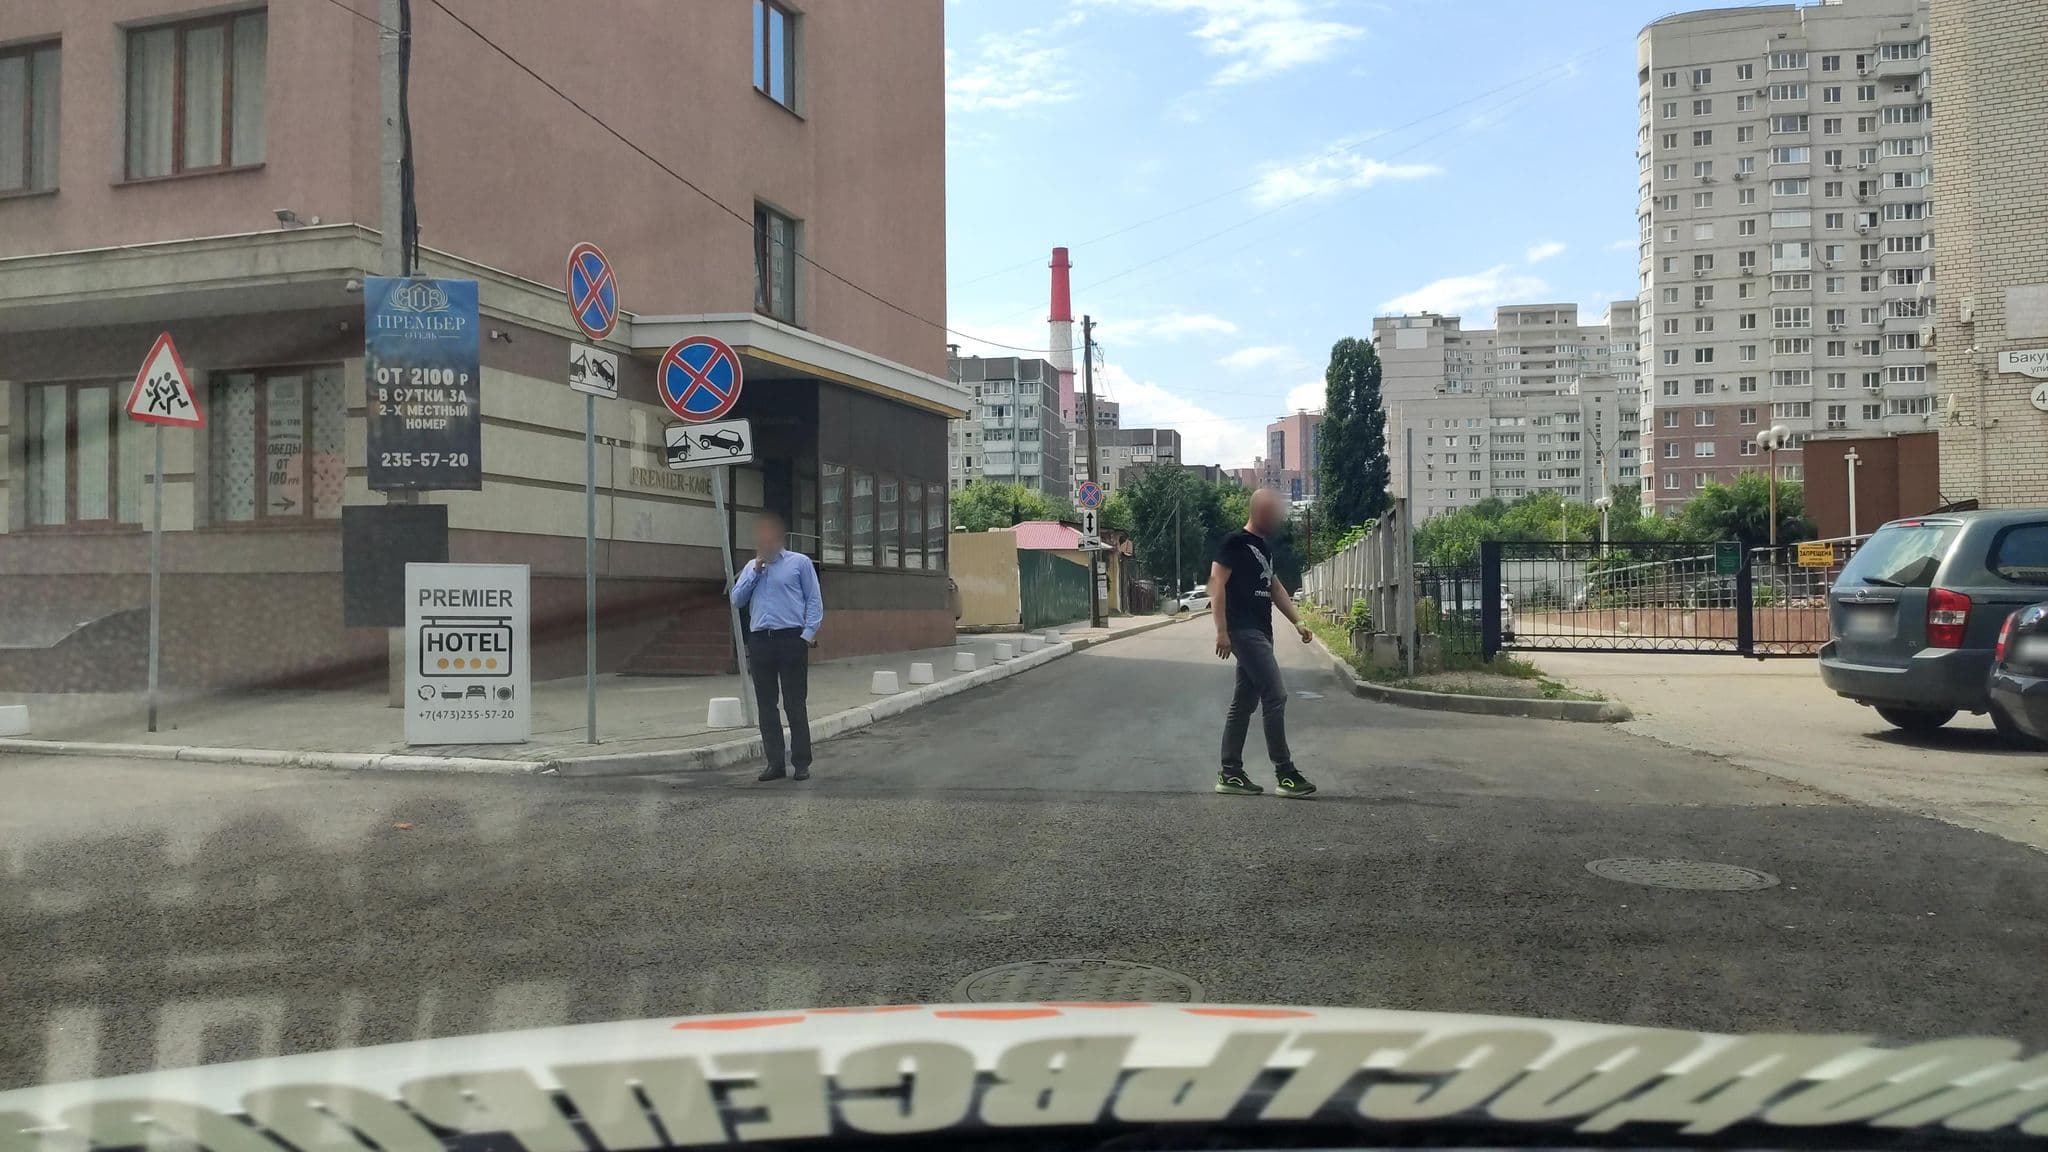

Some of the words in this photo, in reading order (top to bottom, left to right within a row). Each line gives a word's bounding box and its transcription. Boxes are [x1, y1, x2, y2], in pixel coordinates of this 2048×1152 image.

[377, 315, 466, 331] ПРЕМЬЕР
[404, 332, 437, 340] ОТЕЛЬ
[2009, 352, 2048, 364] Баку
[377, 368, 403, 385] ОТ
[411, 368, 454, 386] 2100
[379, 388, 388, 402] В
[394, 388, 444, 403] СУТКИ
[449, 389, 467, 403] ЗА
[379, 405, 402, 416] 2-Х
[407, 404, 468, 417] МЕСТНЫЙ
[406, 418, 447, 430] НОМЕР
[276, 458, 289, 470] ОТ
[381, 453, 469, 468] 235-57-20
[269, 471, 288, 485] 100
[419, 588, 514, 608] PREMIER
[427, 632, 508, 652] HOTEL
[419, 709, 515, 722] +7(473)235-57-20
